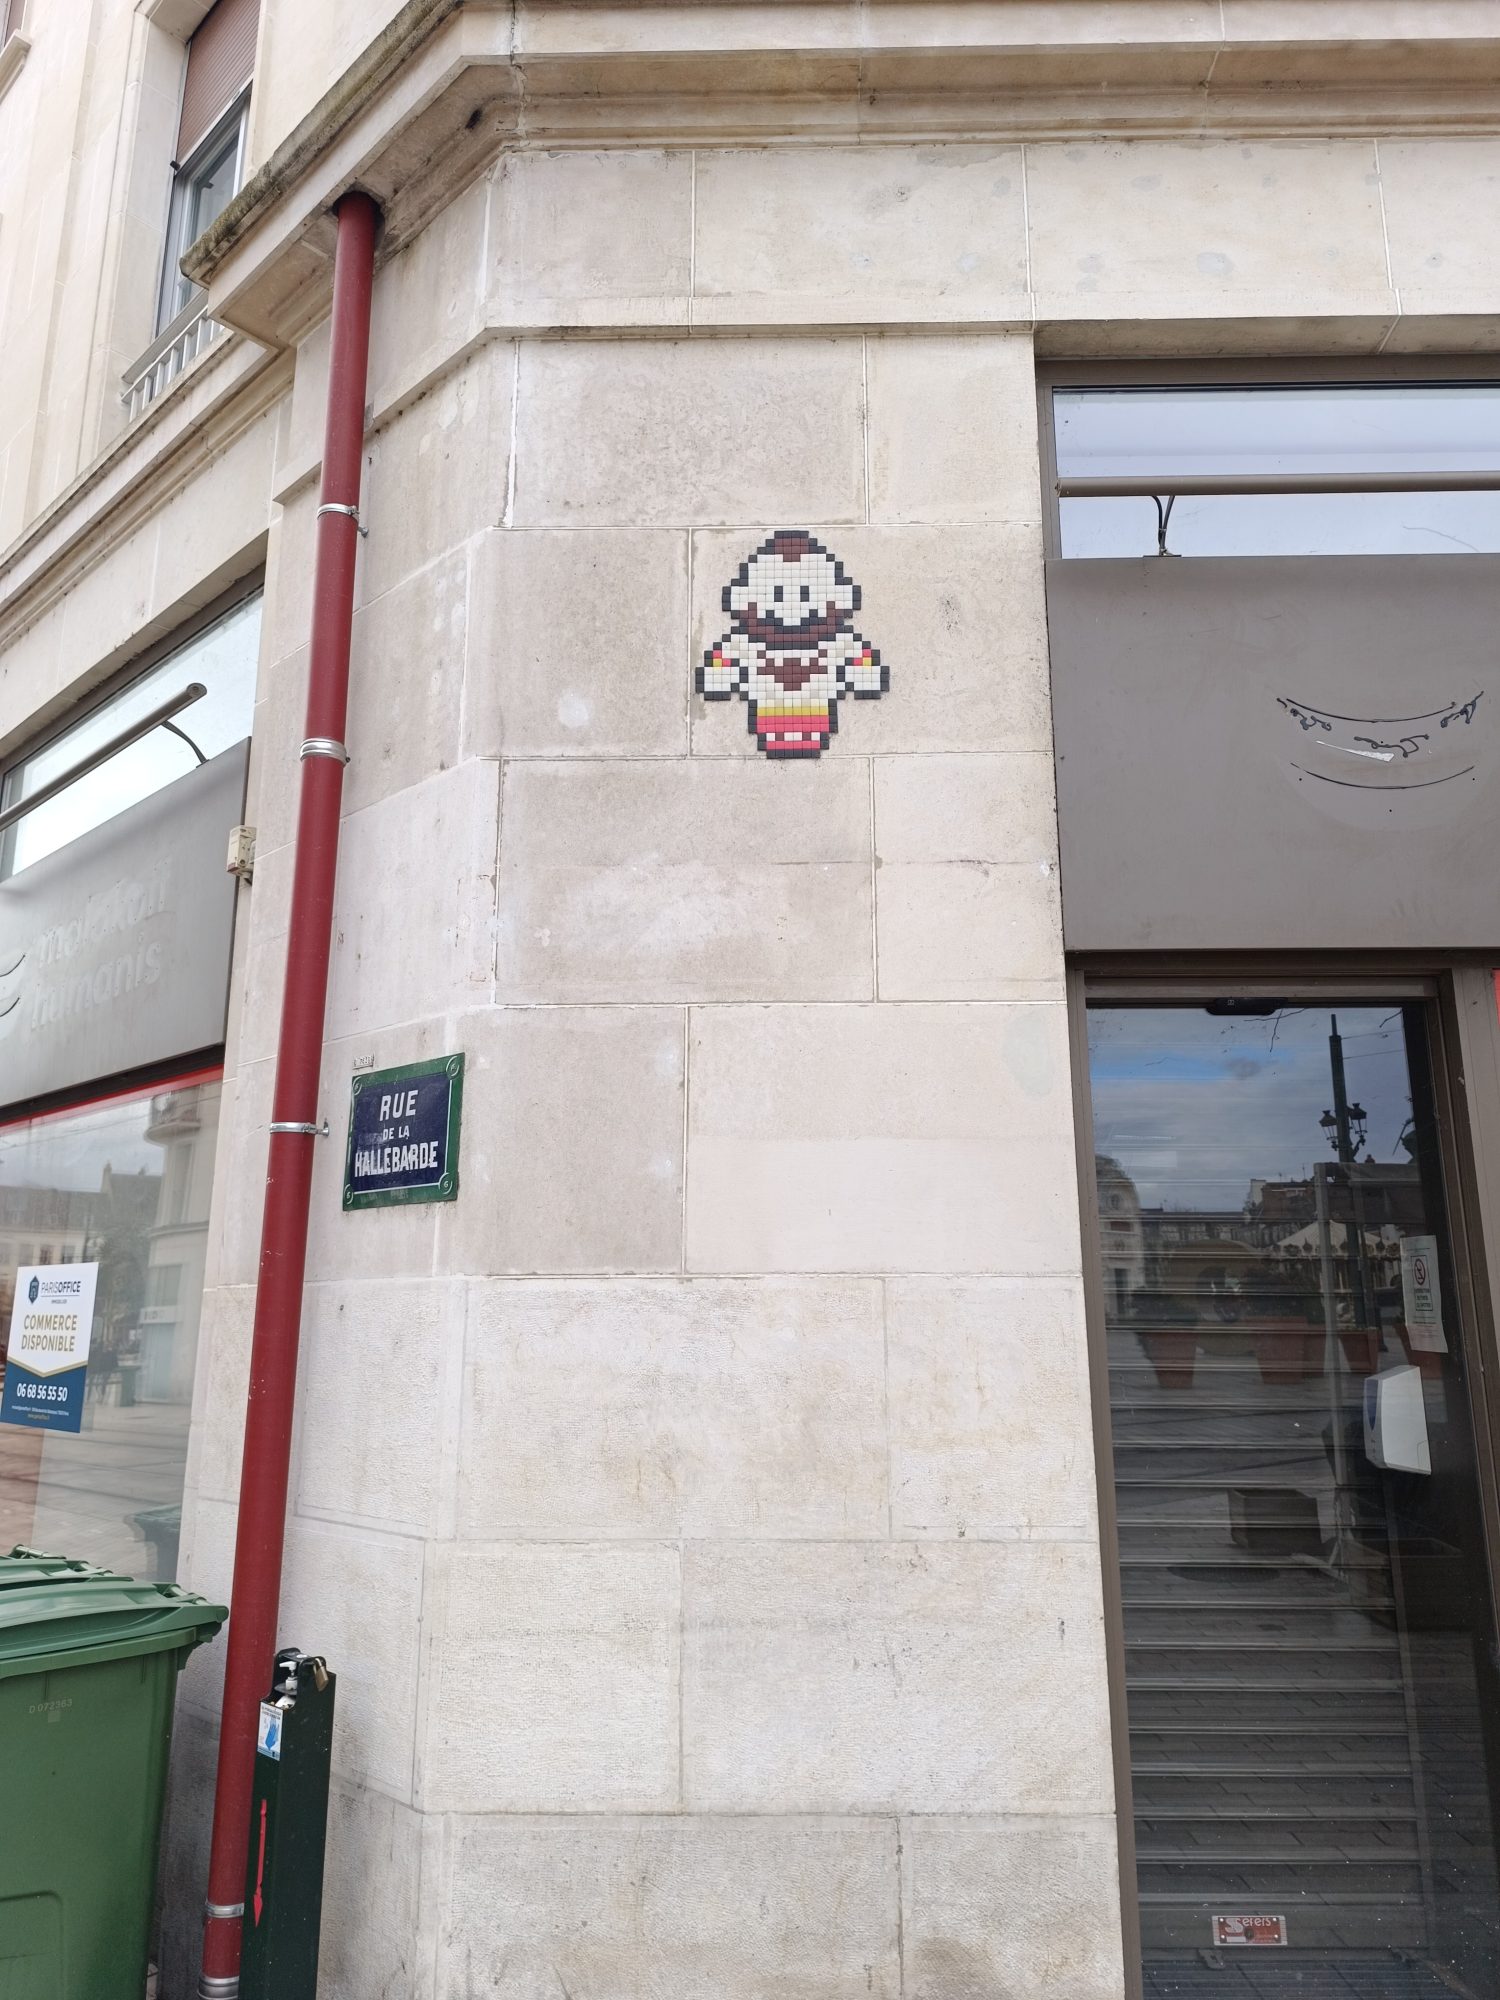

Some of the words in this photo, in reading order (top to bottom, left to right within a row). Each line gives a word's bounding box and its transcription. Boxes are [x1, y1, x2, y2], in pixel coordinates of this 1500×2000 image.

[380, 1089, 419, 1121] RUE
[383, 1127, 394, 1140] DE
[398, 1125, 410, 1139] LA
[354, 1141, 439, 1177] HALLEBARDE
[41, 1280, 81, 1293] PARISOFFICE
[23, 1315, 77, 1330] COMMERCE
[21, 1334, 75, 1352] DISPONIBLE
[16, 1383, 26, 1397] 06
[27, 1384, 36, 1398] 68
[36, 1385, 46, 1399] 56
[47, 1386, 57, 1400] 55
[57, 1387, 68, 1401] 50
